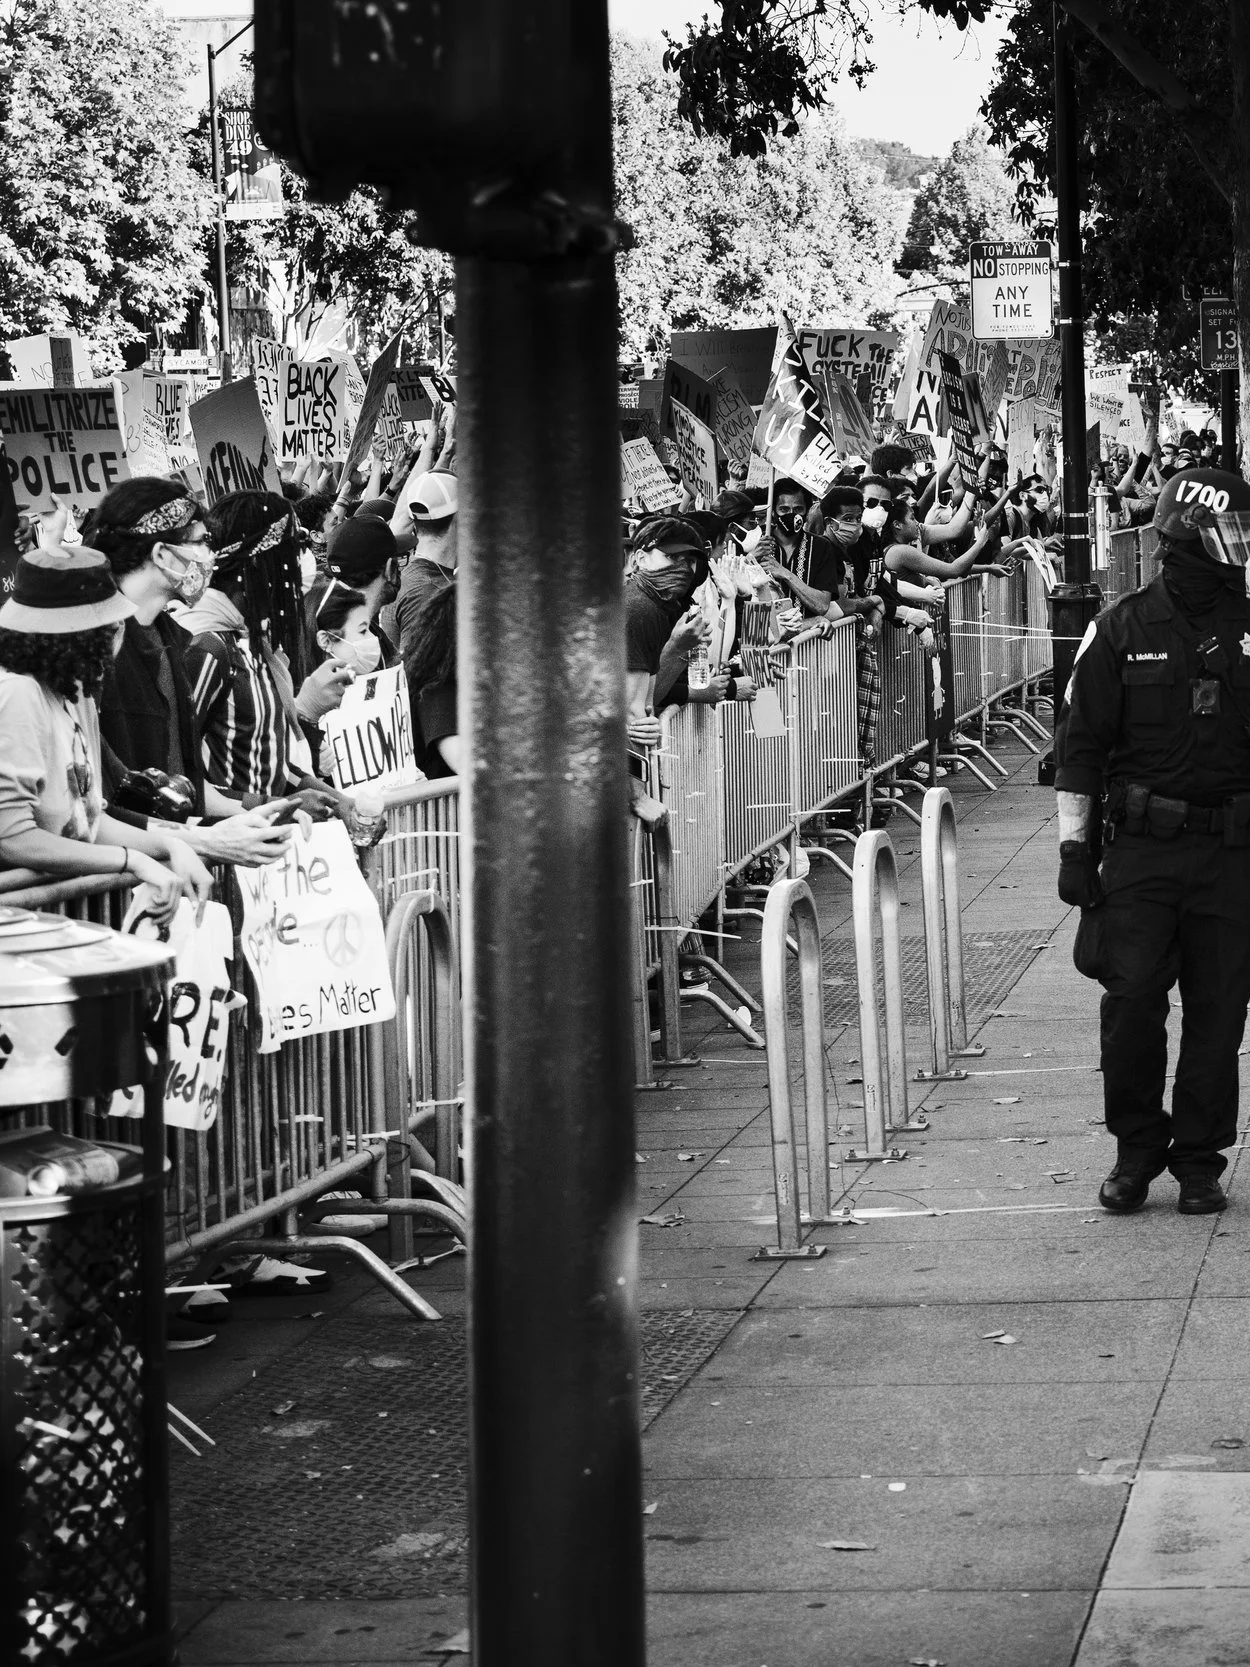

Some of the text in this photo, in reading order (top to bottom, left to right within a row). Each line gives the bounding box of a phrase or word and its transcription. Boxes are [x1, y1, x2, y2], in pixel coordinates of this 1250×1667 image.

[225, 111, 250, 125] SHOP
[225, 125, 251, 140] DINE
[226, 140, 252, 155] 49
[982, 245, 1038, 256] TOW-AWAY
[973, 259, 1048, 277] NO STOPPING
[995, 286, 1028, 300] ANY
[936, 306, 957, 325] NO
[992, 304, 1032, 318] TIME
[799, 332, 866, 359] FUCK
[1216, 330, 1237, 349] 13
[868, 343, 895, 365] THE
[1089, 368, 1122, 379] RESPECT
[287, 363, 339, 406] BLACK
[1090, 392, 1101, 402] WE
[285, 397, 337, 434] LIVES
[1090, 401, 1121, 415] SILENCED
[718, 411, 752, 446] WRONG
[765, 414, 806, 454] US
[44, 431, 76, 452] THE
[282, 429, 341, 458] MATTER!
[6, 451, 118, 496] POLICE
[1175, 480, 1230, 512] 1700
[1136, 652, 1168, 661] McMILLAN
[319, 979, 381, 1025] Matter
